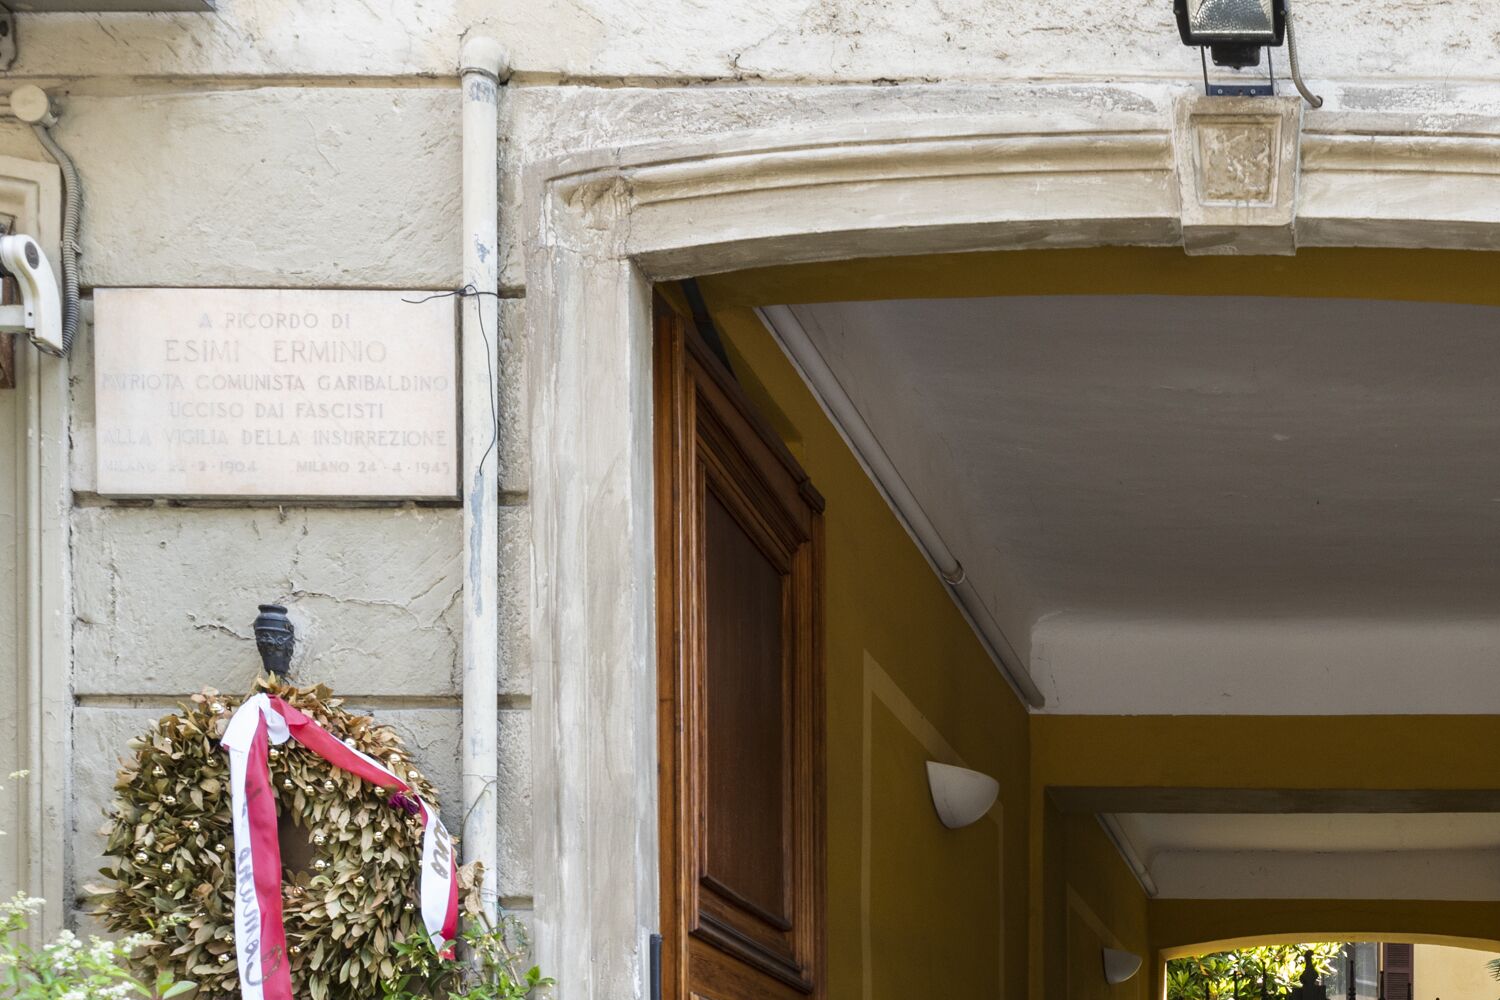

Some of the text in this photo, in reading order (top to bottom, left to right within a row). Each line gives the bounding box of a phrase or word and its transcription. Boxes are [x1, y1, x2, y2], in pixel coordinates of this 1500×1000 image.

[198, 312, 351, 329] A RICORDO DI
[164, 338, 387, 364] ESIMI ERMINIO
[102, 373, 450, 393] PATRIOTA COMUNISTA GARIBALDINO
[168, 402, 385, 419] UCCISO DAI FASCISTI
[102, 429, 448, 448] ALLA VIGILIA DELLA INSURREZIONE
[295, 459, 350, 474] MILANO
